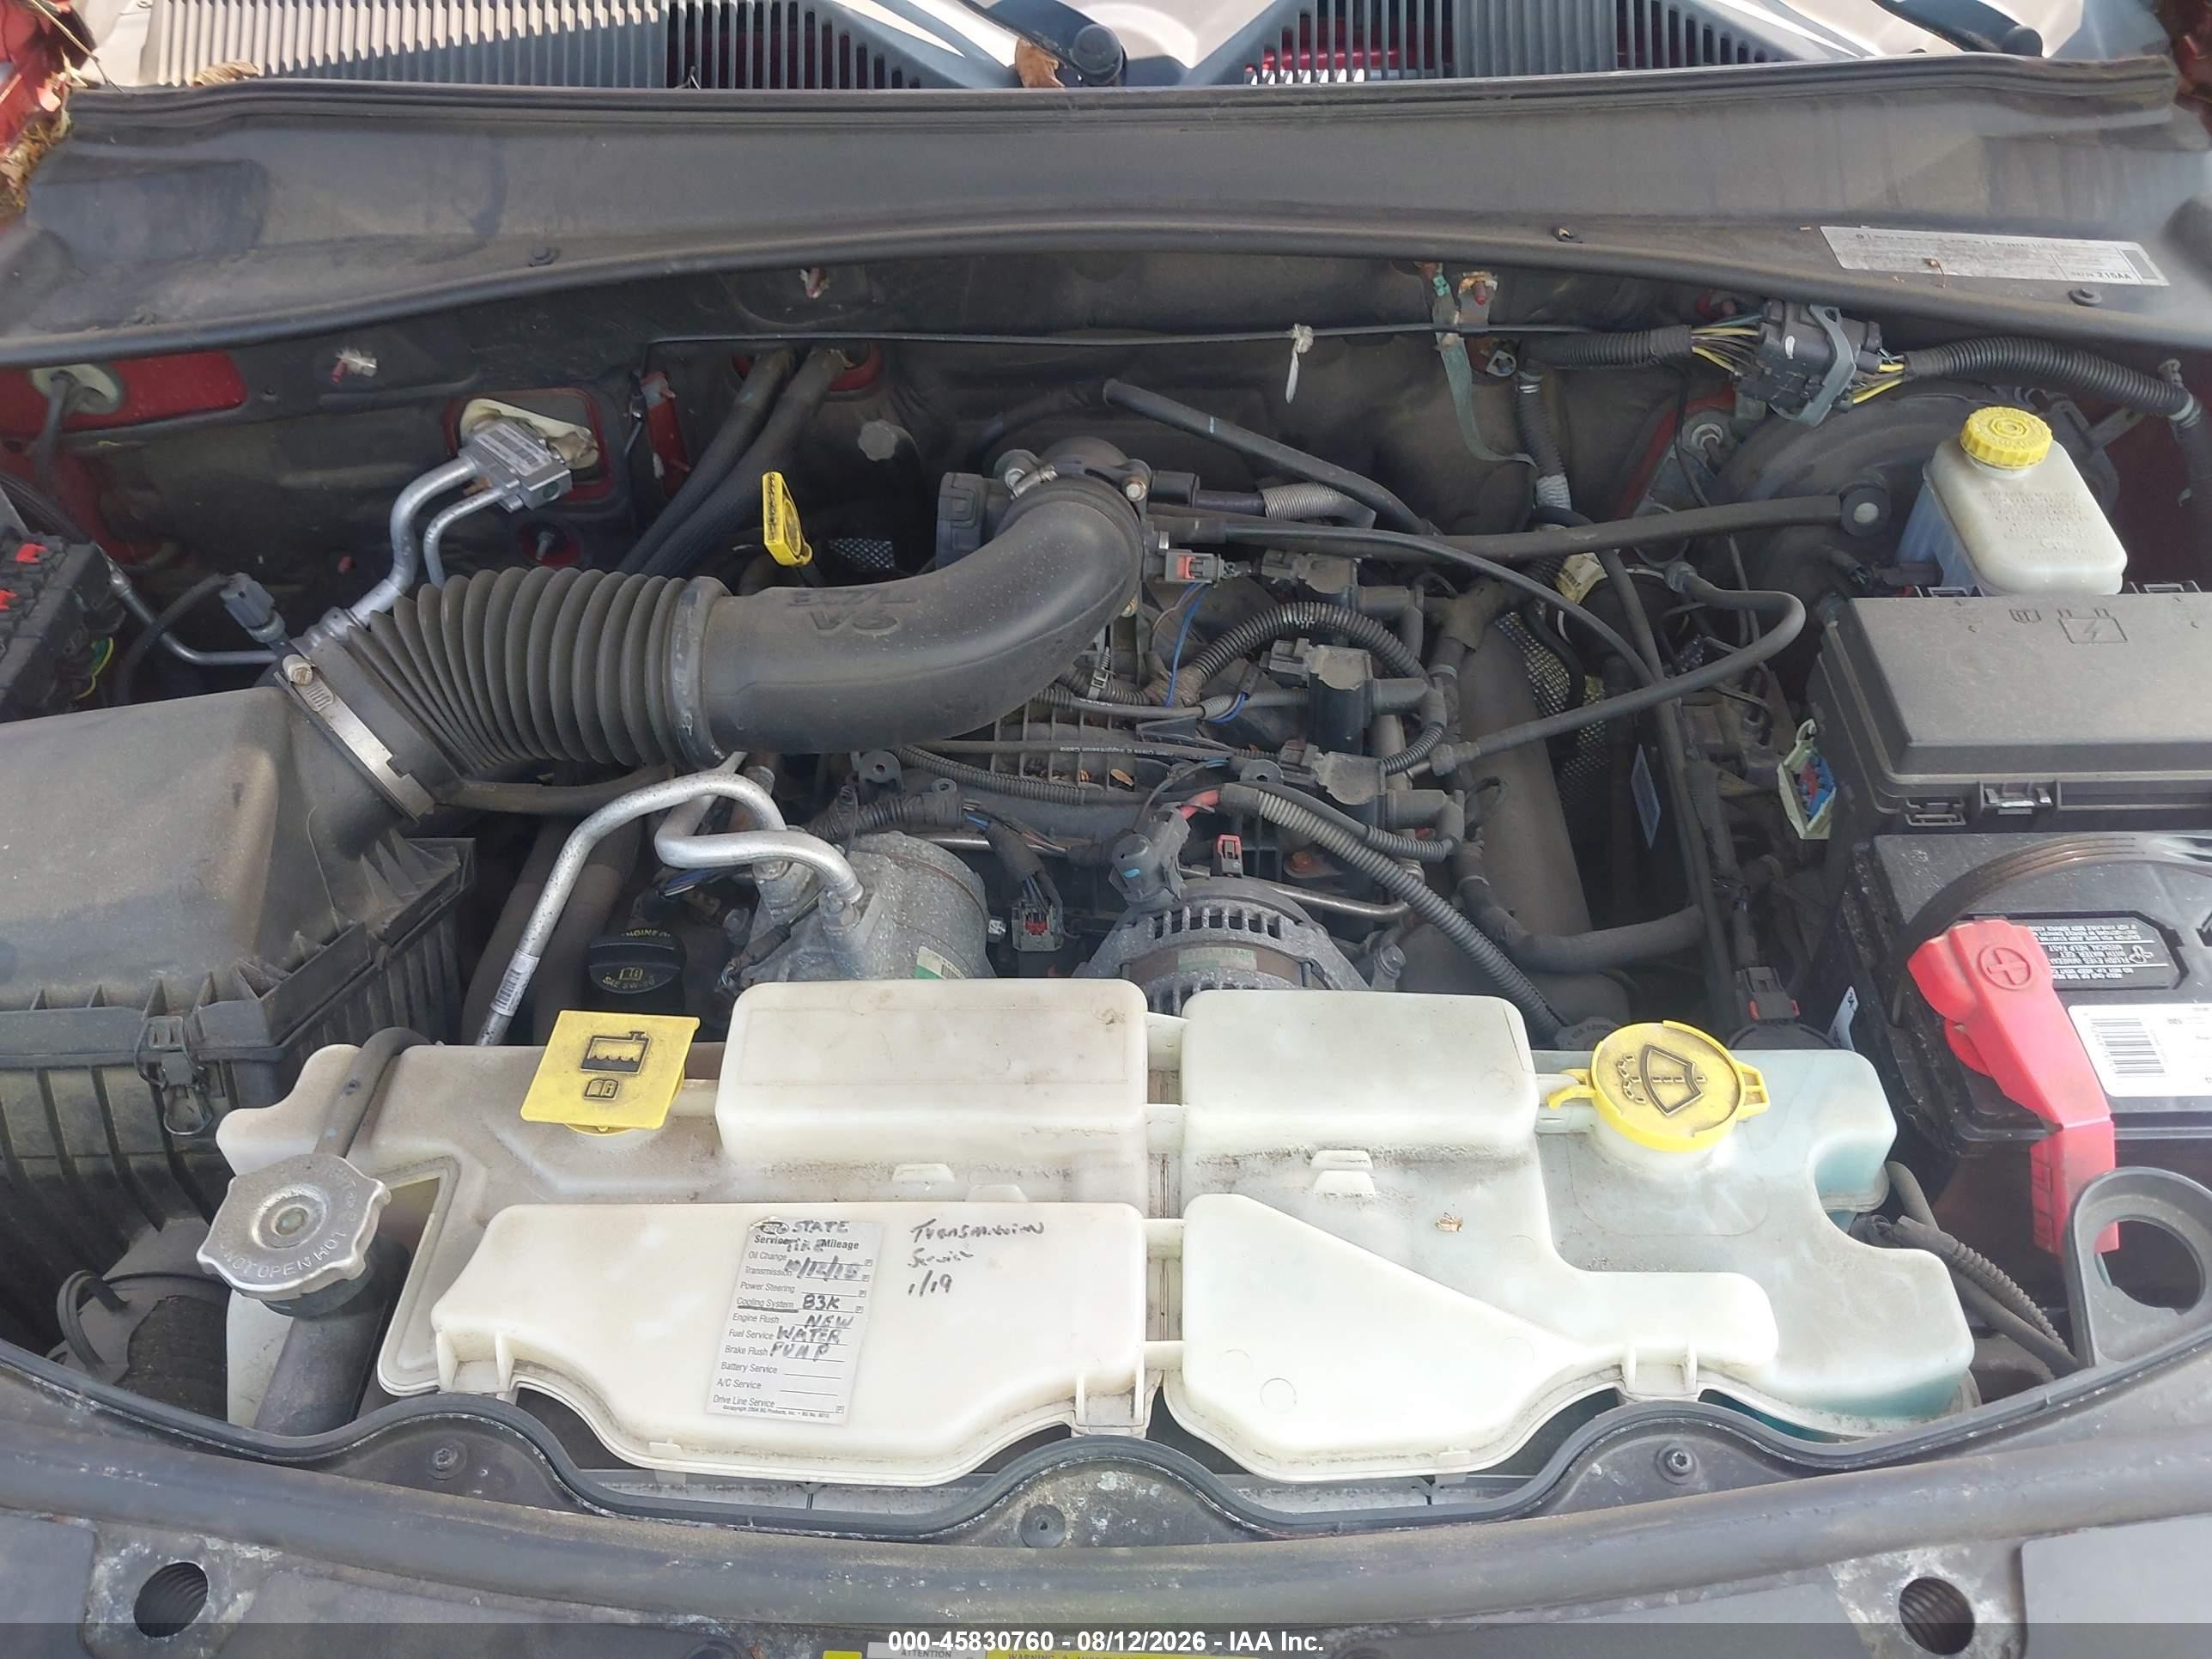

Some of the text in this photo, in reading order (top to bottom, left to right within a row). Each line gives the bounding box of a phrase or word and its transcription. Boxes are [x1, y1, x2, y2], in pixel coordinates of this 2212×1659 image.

[792, 1219, 850, 1234] STATE
[822, 1239, 860, 1251] Mileage
[748, 1250, 787, 1261] Oil Change
[258, 1258, 310, 1278] OPEN
[744, 1266, 793, 1277] Transmission
[740, 1281, 796, 1293] Power Steering
[908, 1269, 952, 1297] 1/19
[736, 1297, 794, 1309] Cooling System
[732, 1313, 780, 1323] Engine Flush
[805, 1314, 854, 1328] NEW
[728, 1328, 775, 1340] Fuel Service
[776, 1326, 840, 1344] WATER
[725, 1345, 769, 1357] Brake Flush
[769, 1341, 830, 1362] PUMP
[720, 1361, 778, 1374] Battery Service
[716, 1378, 762, 1389] A/C Service
[713, 1395, 775, 1408] Drive Line Service
[901, 1649, 952, 1657] ATTENTION
